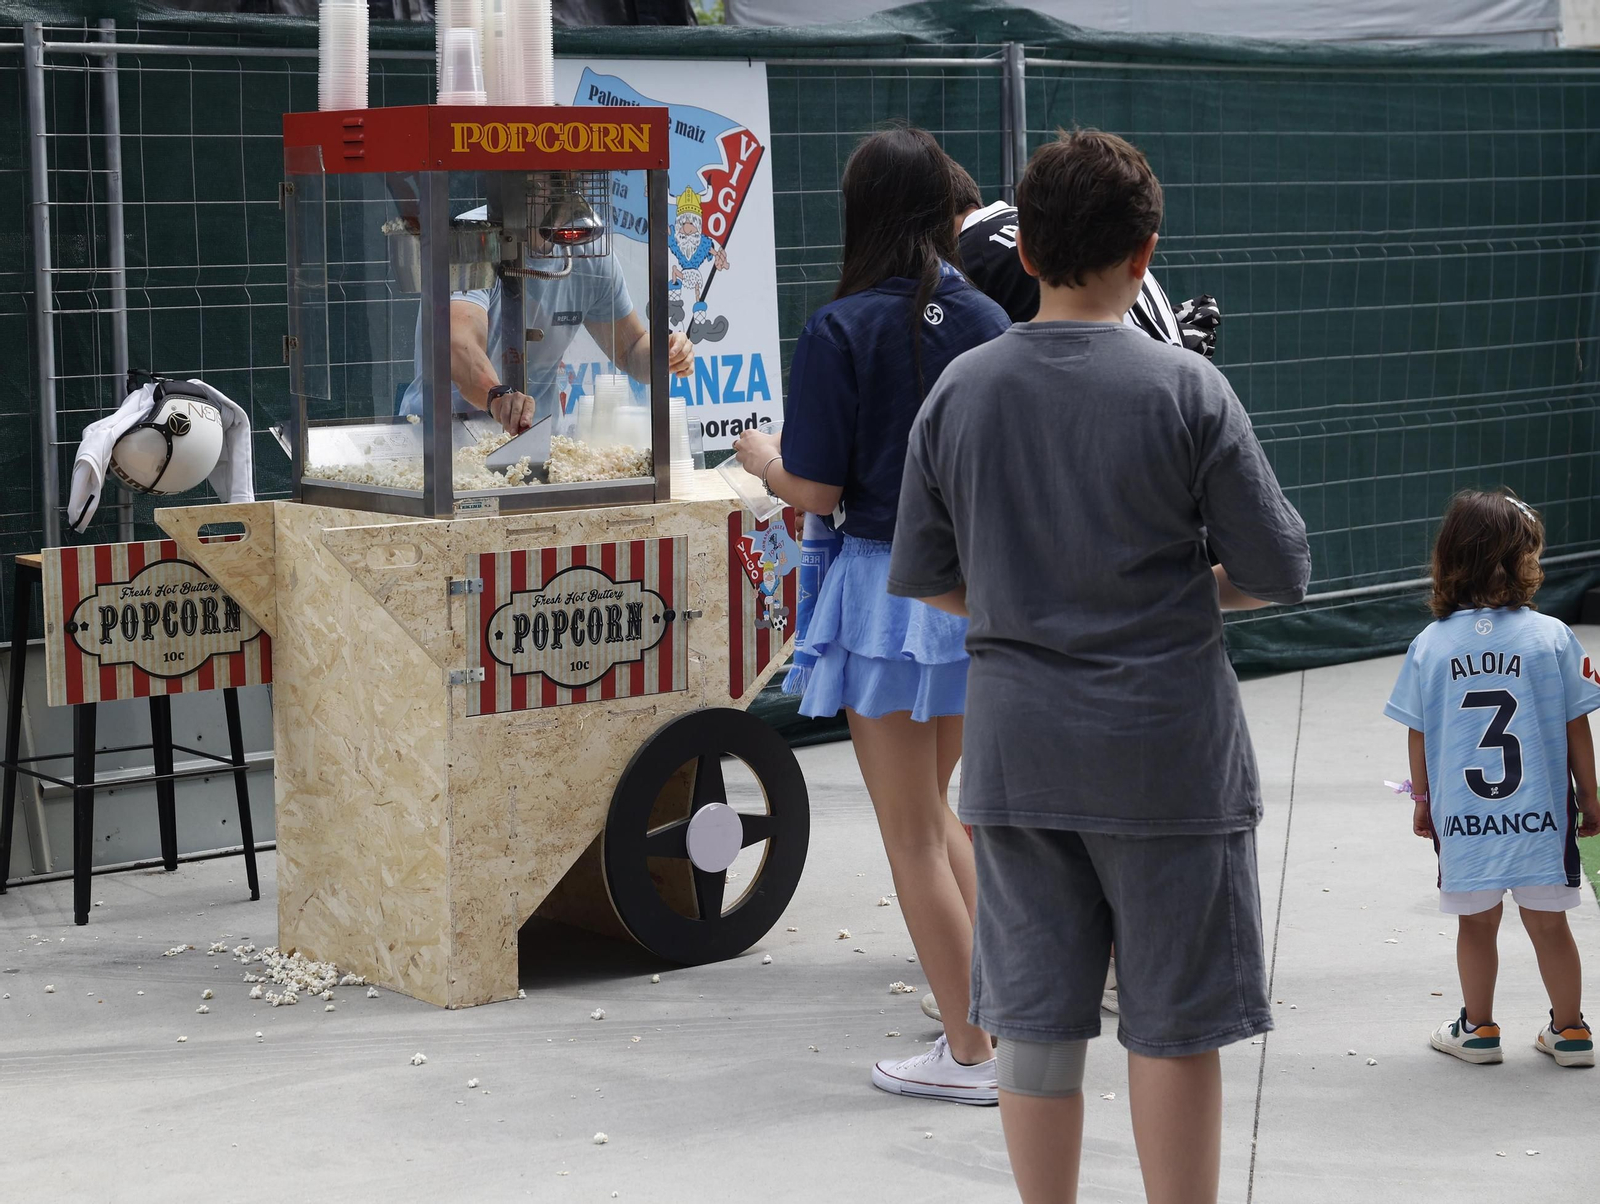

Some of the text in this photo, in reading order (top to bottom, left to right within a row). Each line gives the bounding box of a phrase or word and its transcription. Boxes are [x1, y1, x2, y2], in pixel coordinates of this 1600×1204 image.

[588, 84, 640, 107] Palom
[451, 122, 651, 153] POPCORN
[675, 119, 706, 144] maiz
[708, 134, 757, 237] VIGO
[737, 541, 759, 580] VIGO
[120, 581, 220, 600] Fresh Hot Buttery
[532, 589, 624, 608] Fresh Hot Buttery
[99, 595, 241, 644] POPCORN
[512, 601, 643, 653] POPCORN
[1450, 651, 1521, 681] ALOIA
[1460, 689, 1524, 800] 3
